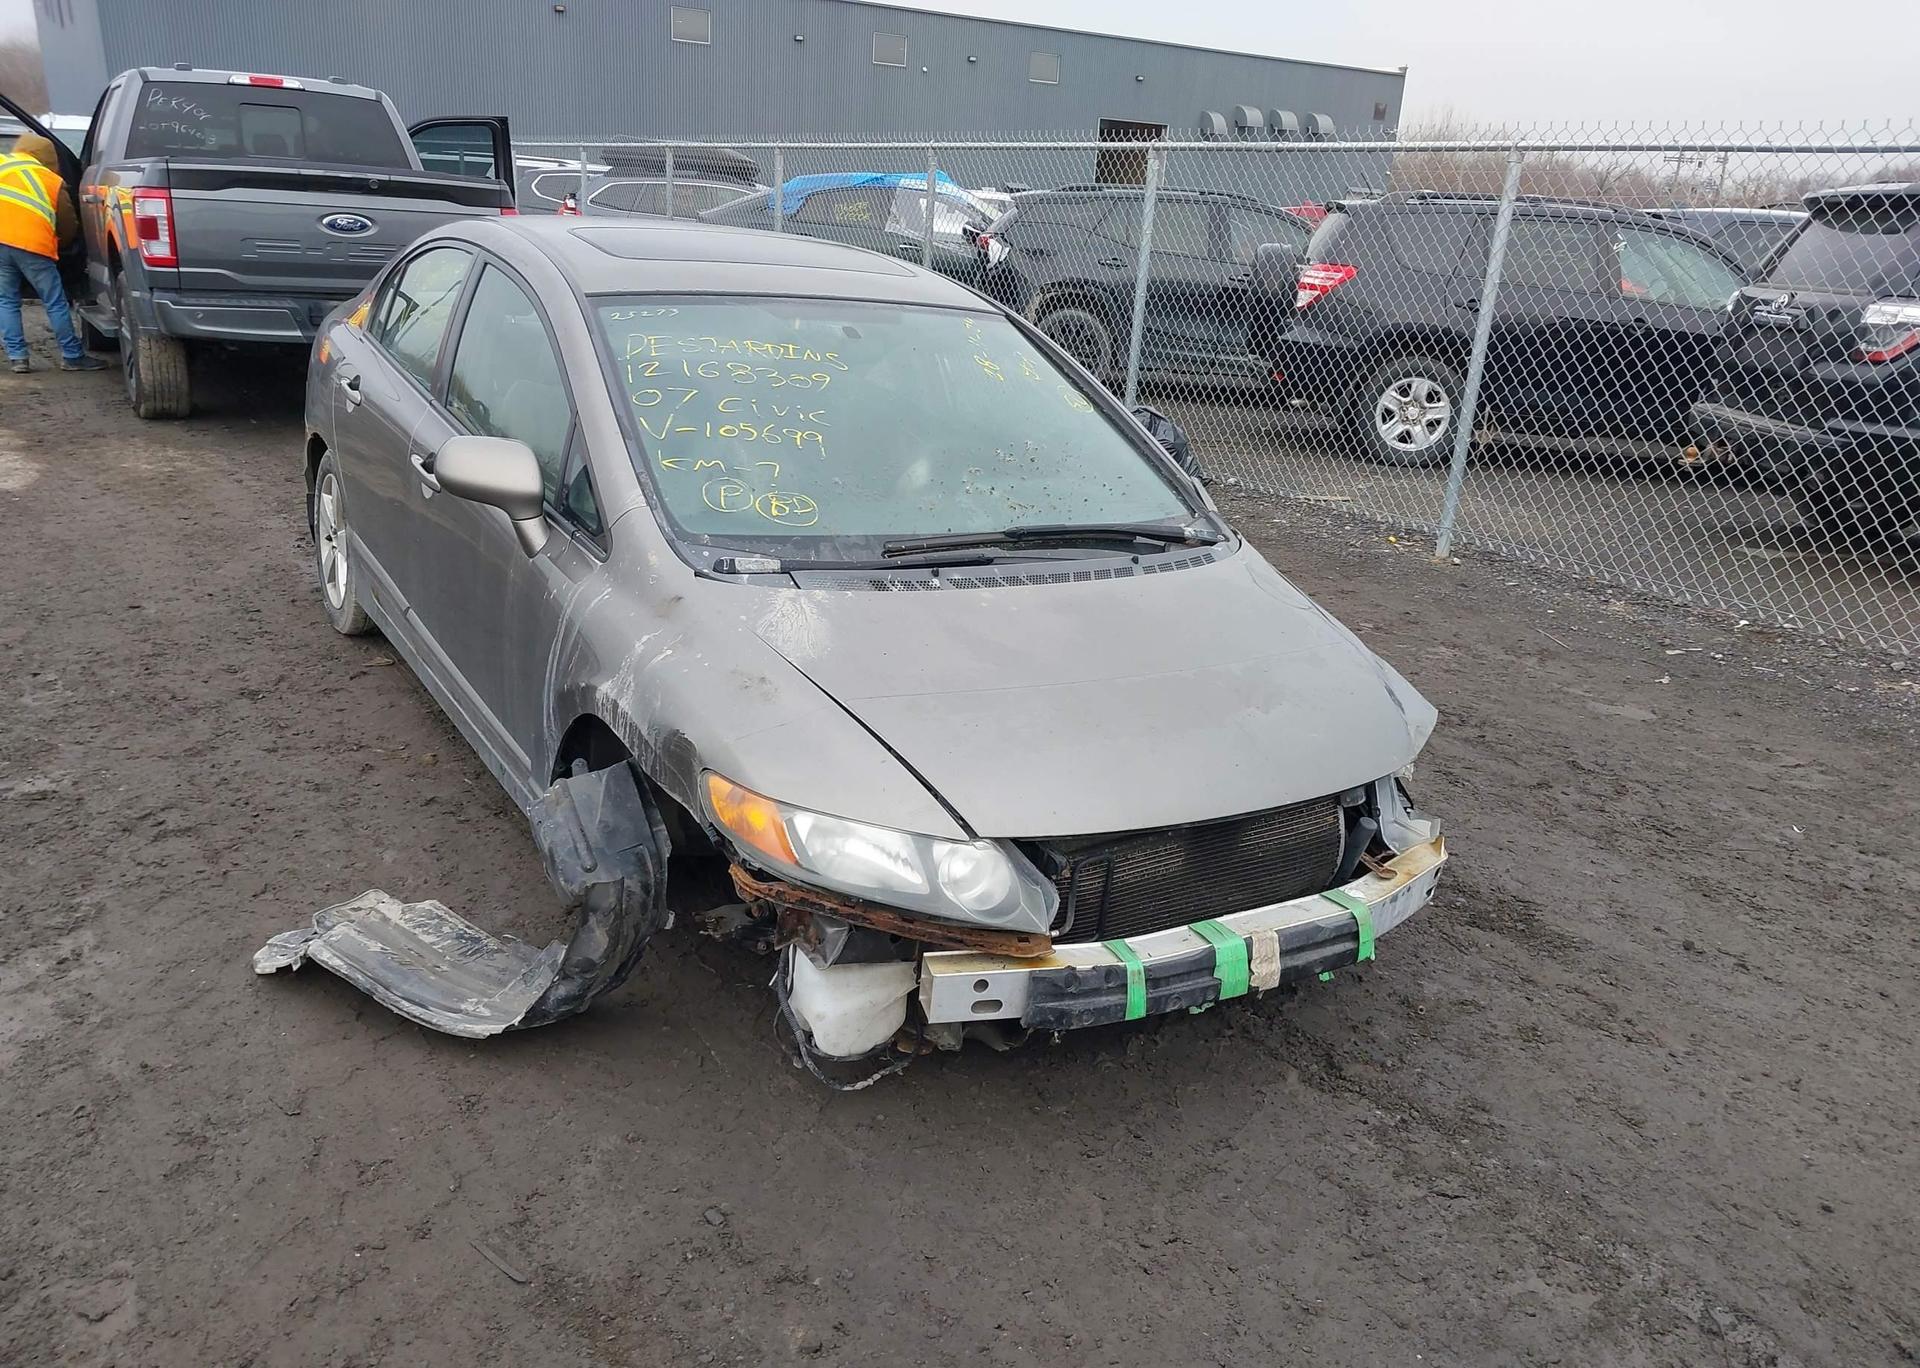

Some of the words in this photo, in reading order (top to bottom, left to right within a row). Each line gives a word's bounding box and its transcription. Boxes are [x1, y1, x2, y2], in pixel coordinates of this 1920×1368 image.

[240, 237, 407, 263] F-15
[618, 333, 849, 371] DESJARDINS
[632, 386, 699, 410] 07
